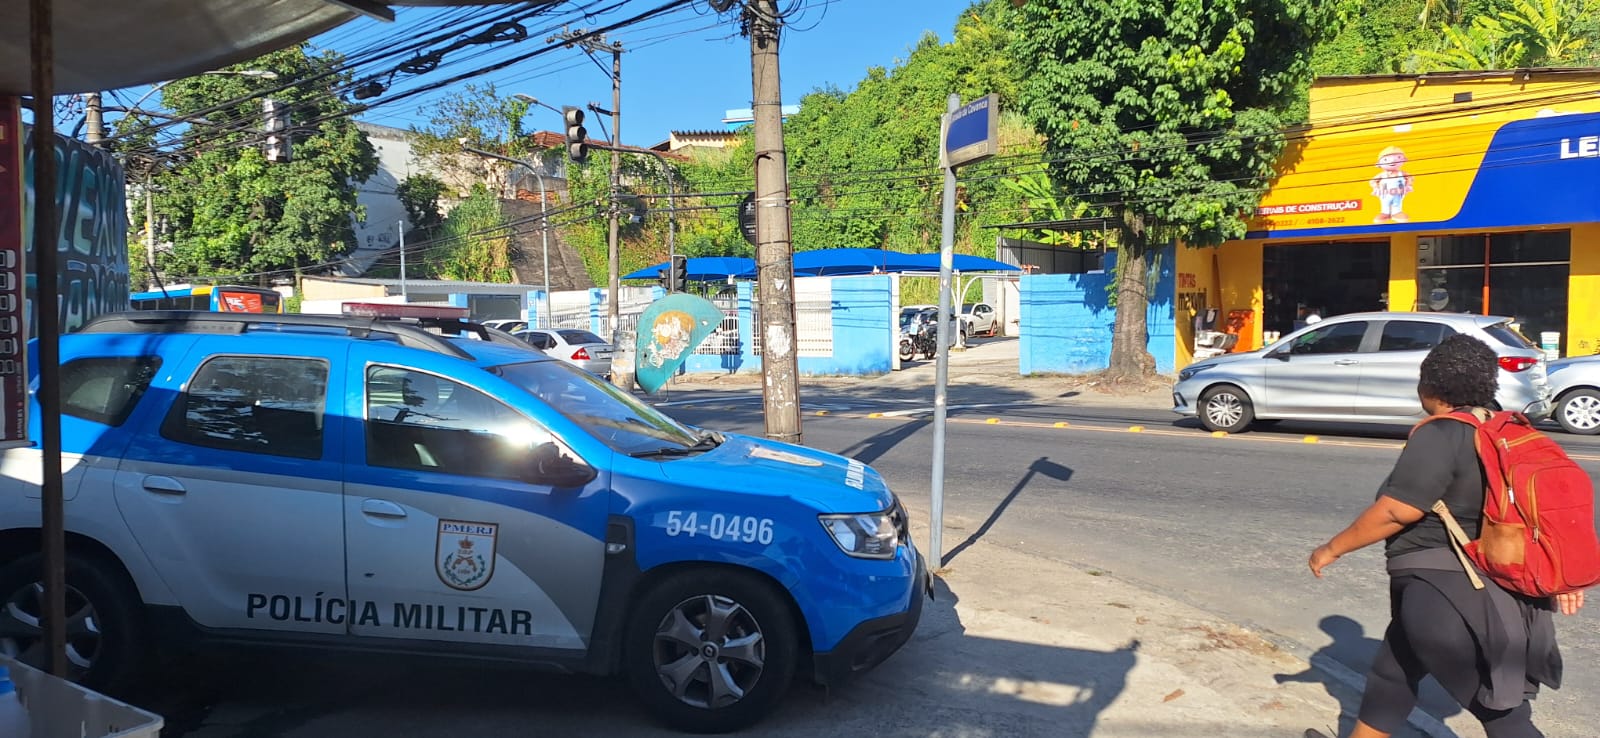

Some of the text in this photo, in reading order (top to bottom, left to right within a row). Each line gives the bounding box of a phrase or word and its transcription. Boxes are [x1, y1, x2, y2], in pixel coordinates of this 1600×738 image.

[1560, 136, 1600, 159] LE
[1286, 205, 1298, 213] DE
[1299, 201, 1358, 211] CONSTRUÇÃO
[443, 523, 493, 535] PMERJ
[666, 510, 774, 545] 54-0496
[247, 592, 533, 635] POLÍCIA MILITAR
